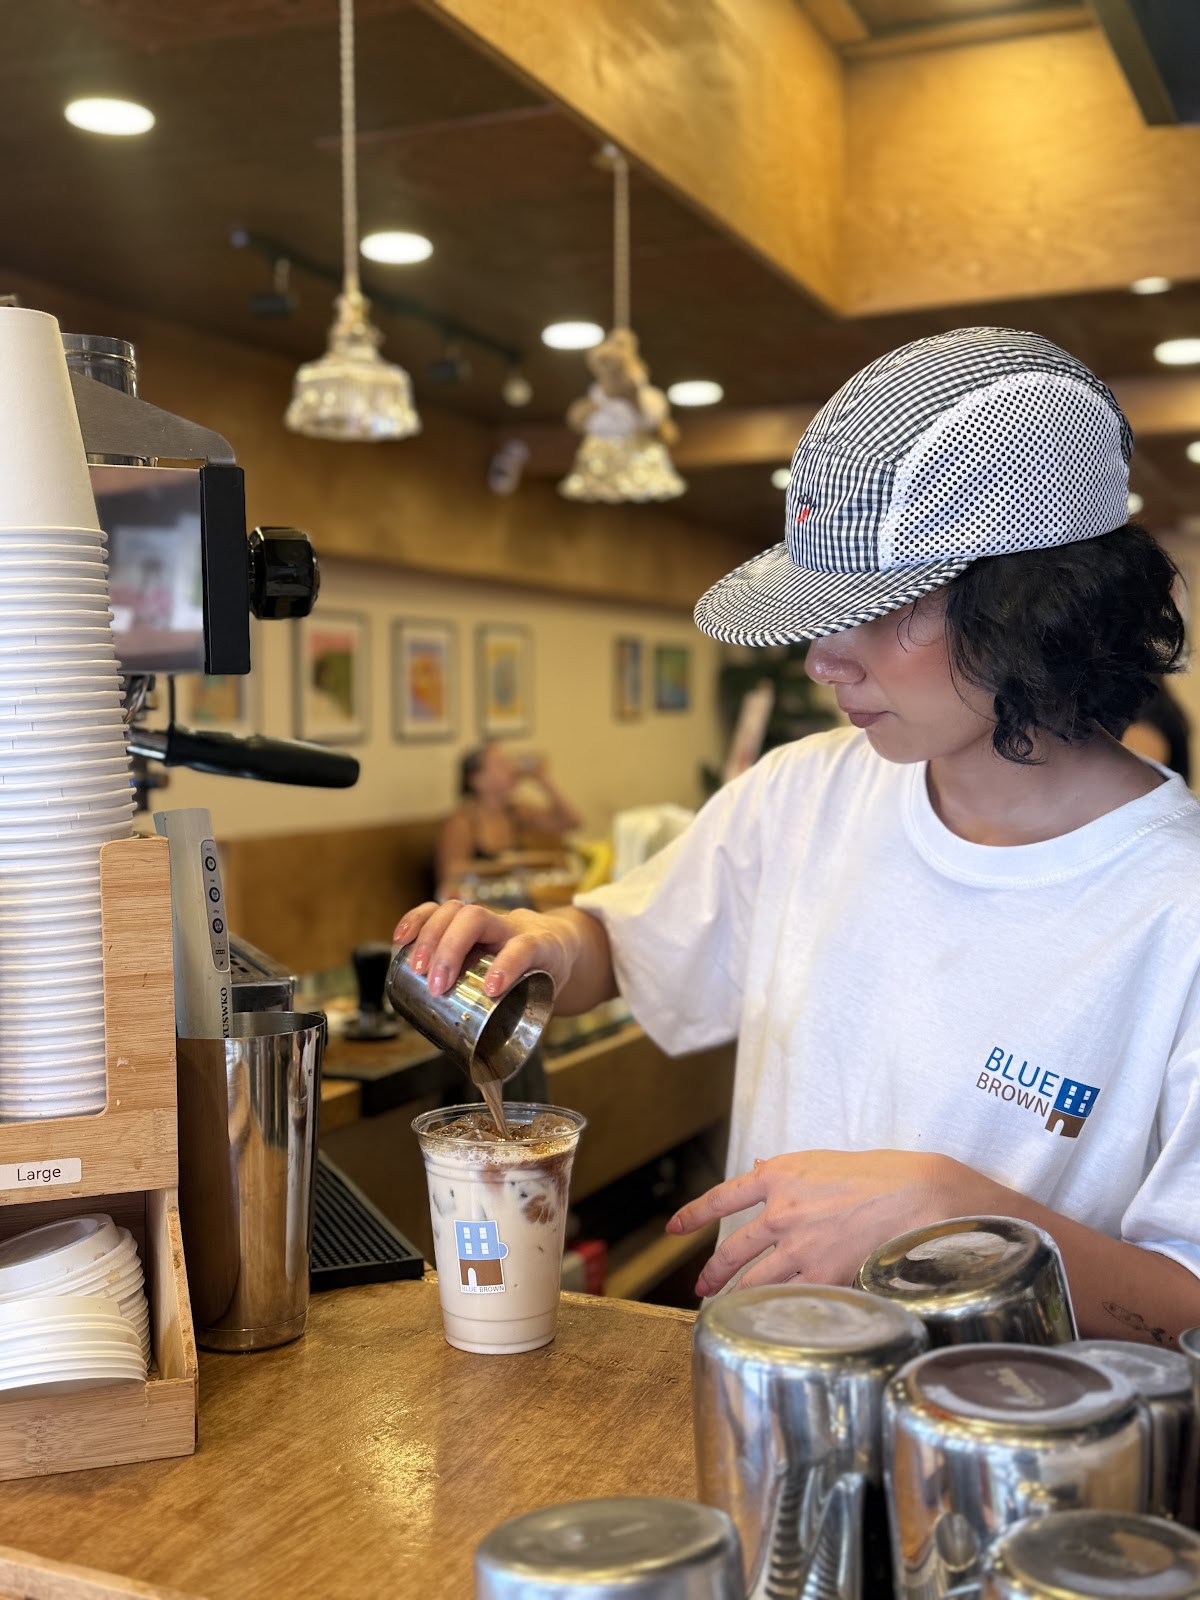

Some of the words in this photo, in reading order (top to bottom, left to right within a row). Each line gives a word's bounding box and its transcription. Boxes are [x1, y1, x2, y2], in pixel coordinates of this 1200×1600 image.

[985, 1046, 1060, 1098] BLUE
[976, 1071, 1050, 1118] BROWN
[17, 1168, 61, 1183] Large
[479, 1285, 505, 1293] BROWN
